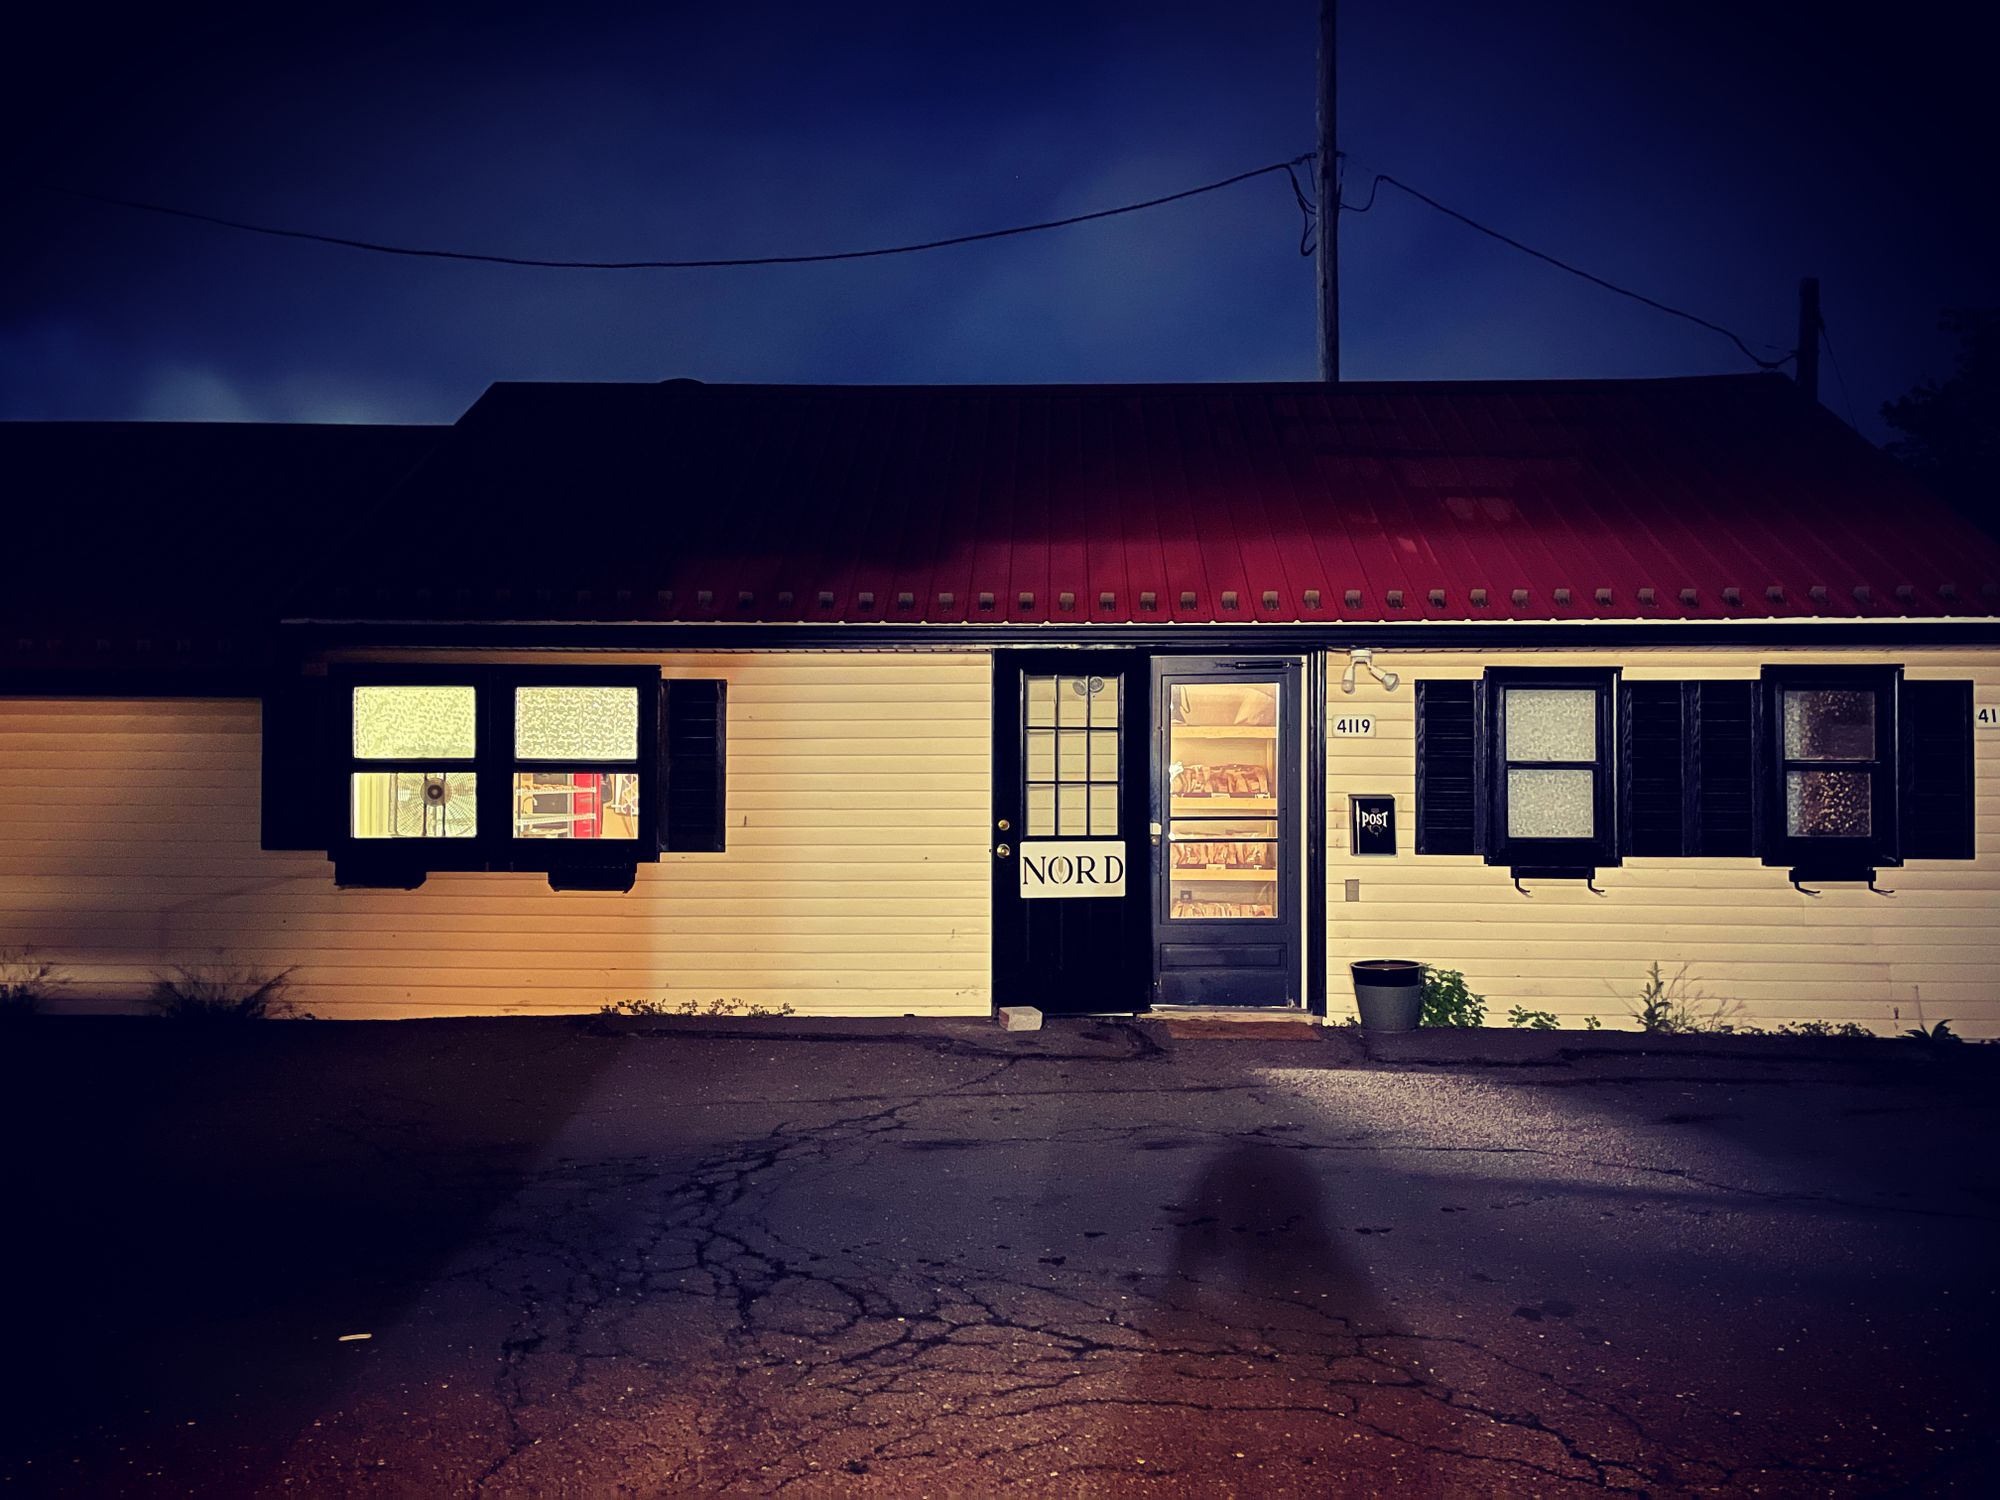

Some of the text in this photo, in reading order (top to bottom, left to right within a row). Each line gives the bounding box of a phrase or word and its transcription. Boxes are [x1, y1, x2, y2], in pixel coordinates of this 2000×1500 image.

[1337, 719, 1370, 733] 4119
[1361, 810, 1388, 828] POST
[1022, 855, 1124, 885] NORD
